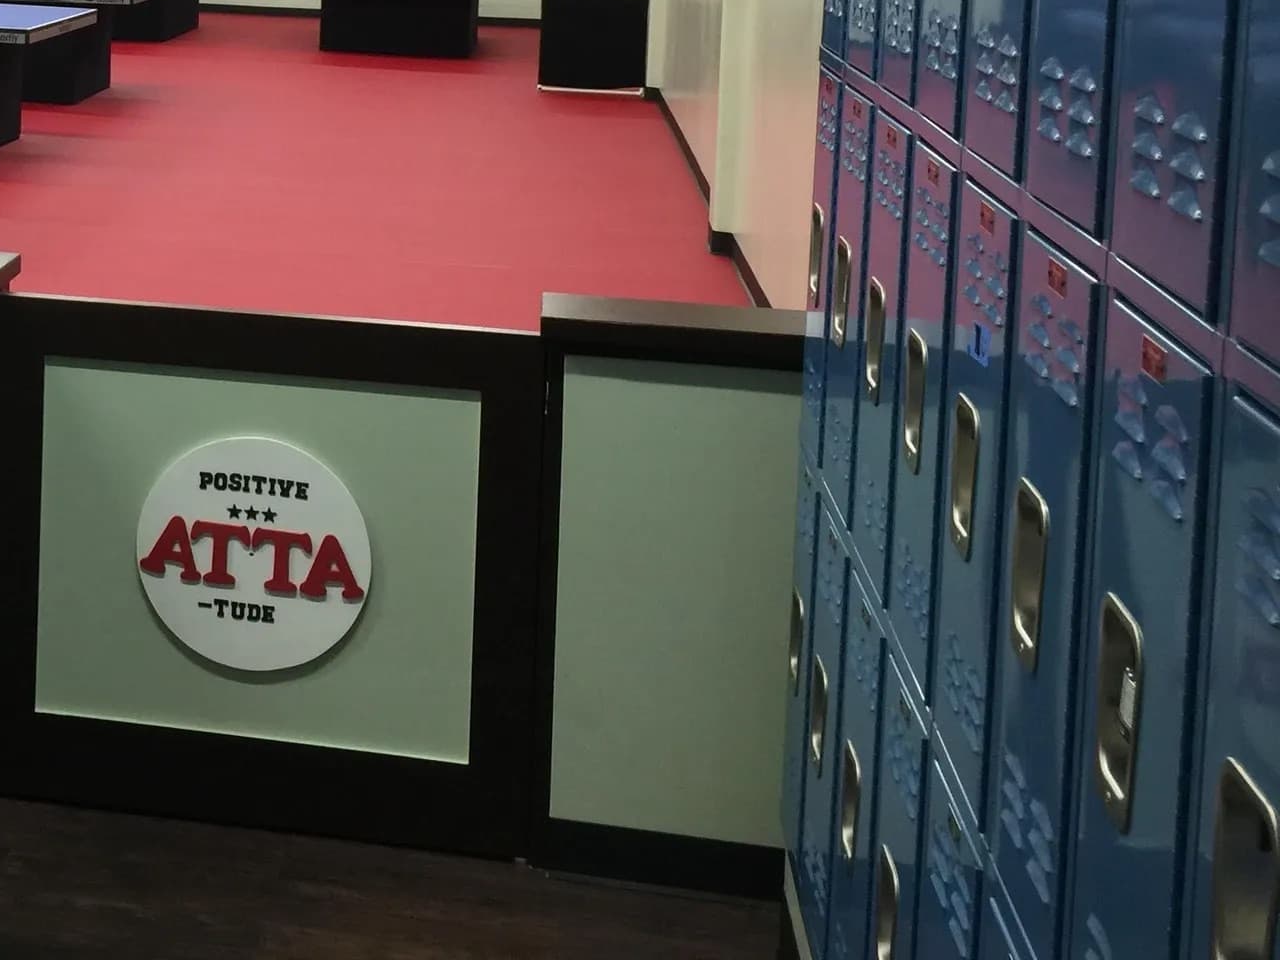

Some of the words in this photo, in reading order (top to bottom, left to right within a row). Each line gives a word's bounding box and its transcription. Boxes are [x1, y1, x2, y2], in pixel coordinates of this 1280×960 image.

[199, 471, 309, 500] POSITIVE
[140, 515, 364, 602] ATTA
[198, 598, 275, 624] -TUDE
